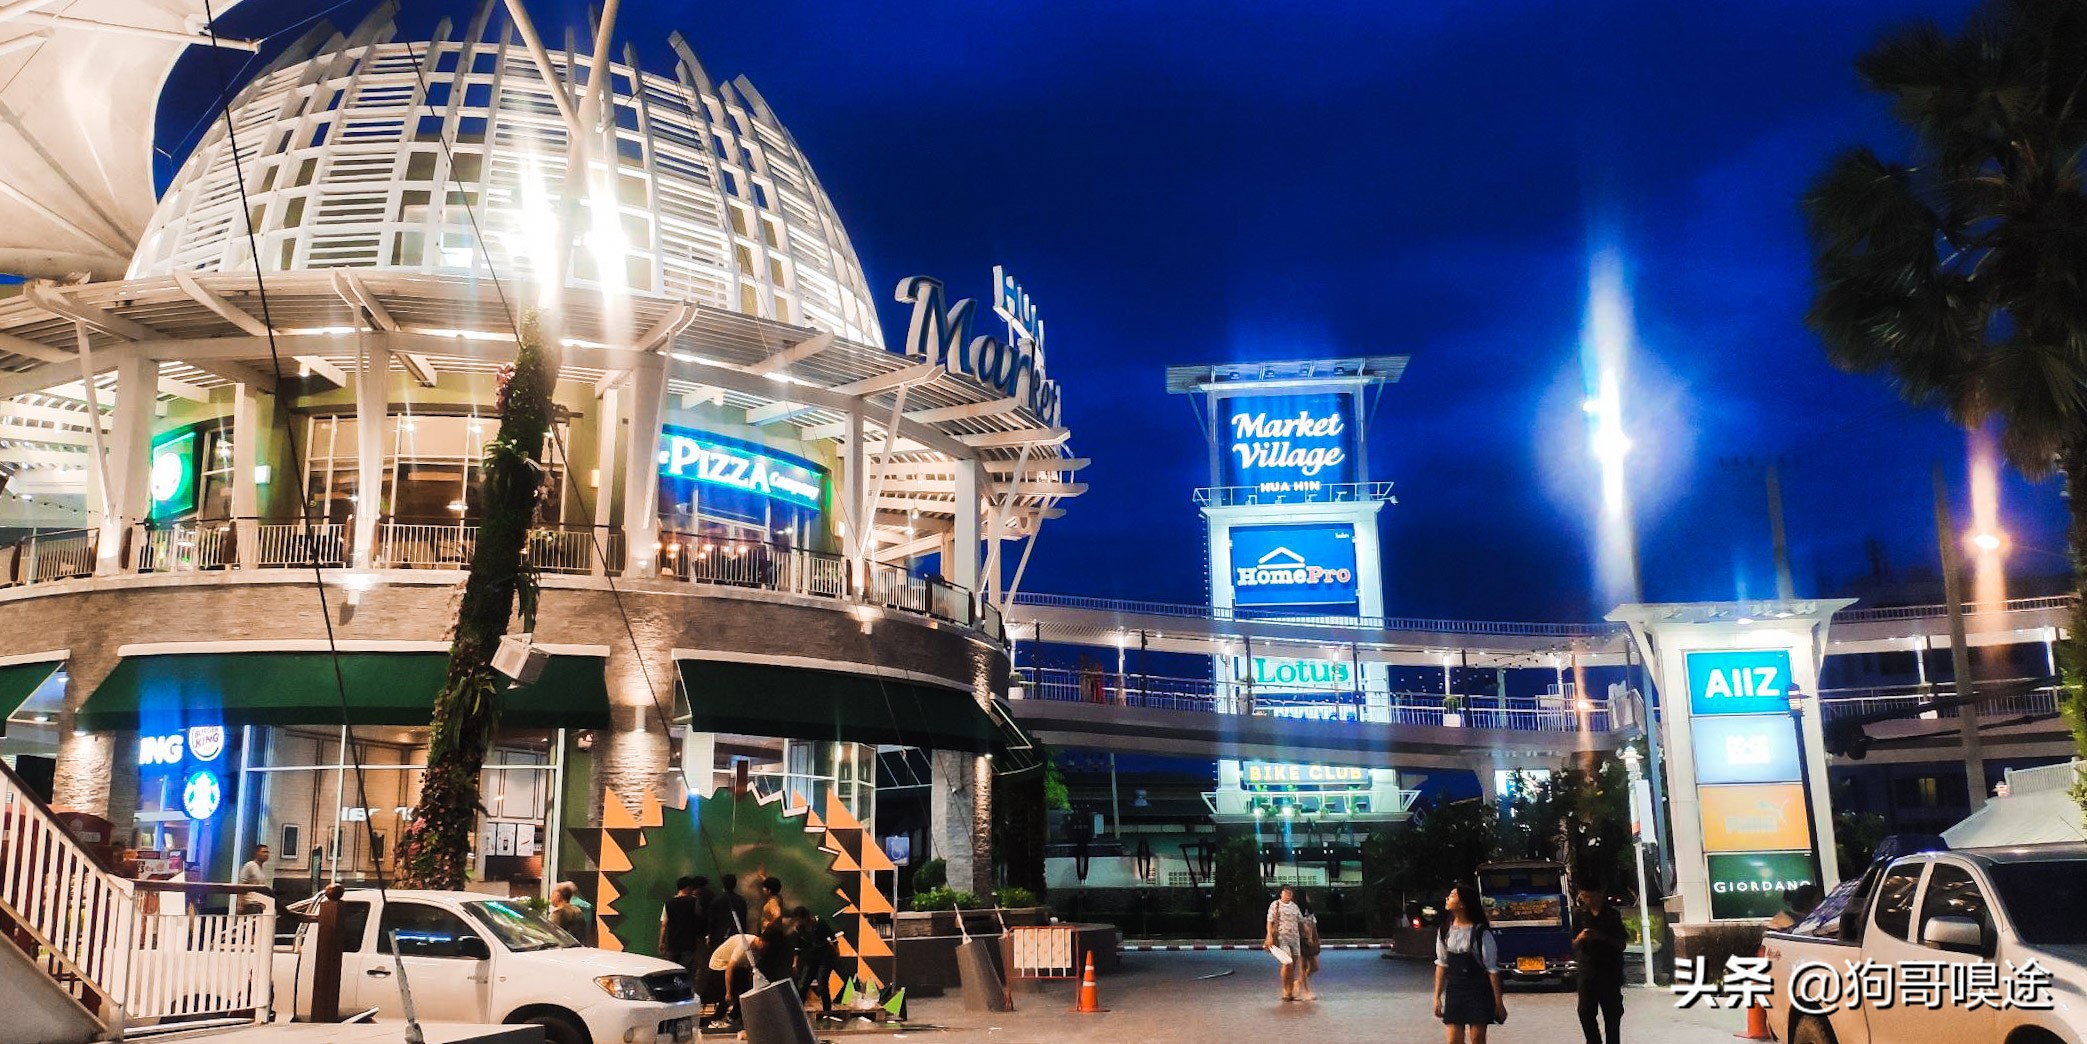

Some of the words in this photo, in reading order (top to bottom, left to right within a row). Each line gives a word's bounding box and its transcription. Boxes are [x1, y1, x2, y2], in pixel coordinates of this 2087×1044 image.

[1231, 411, 1344, 440] Market
[668, 436, 771, 494] PIZZA
[1232, 441, 1344, 476] Village
[1260, 482, 1289, 493] HUA
[1293, 481, 1320, 491] HIN
[1237, 567, 1350, 586] HomePro
[1255, 658, 1349, 683] Lotus
[194, 732, 219, 748] KING
[1250, 766, 1300, 781] BIKE
[1309, 766, 1361, 781] CLUB
